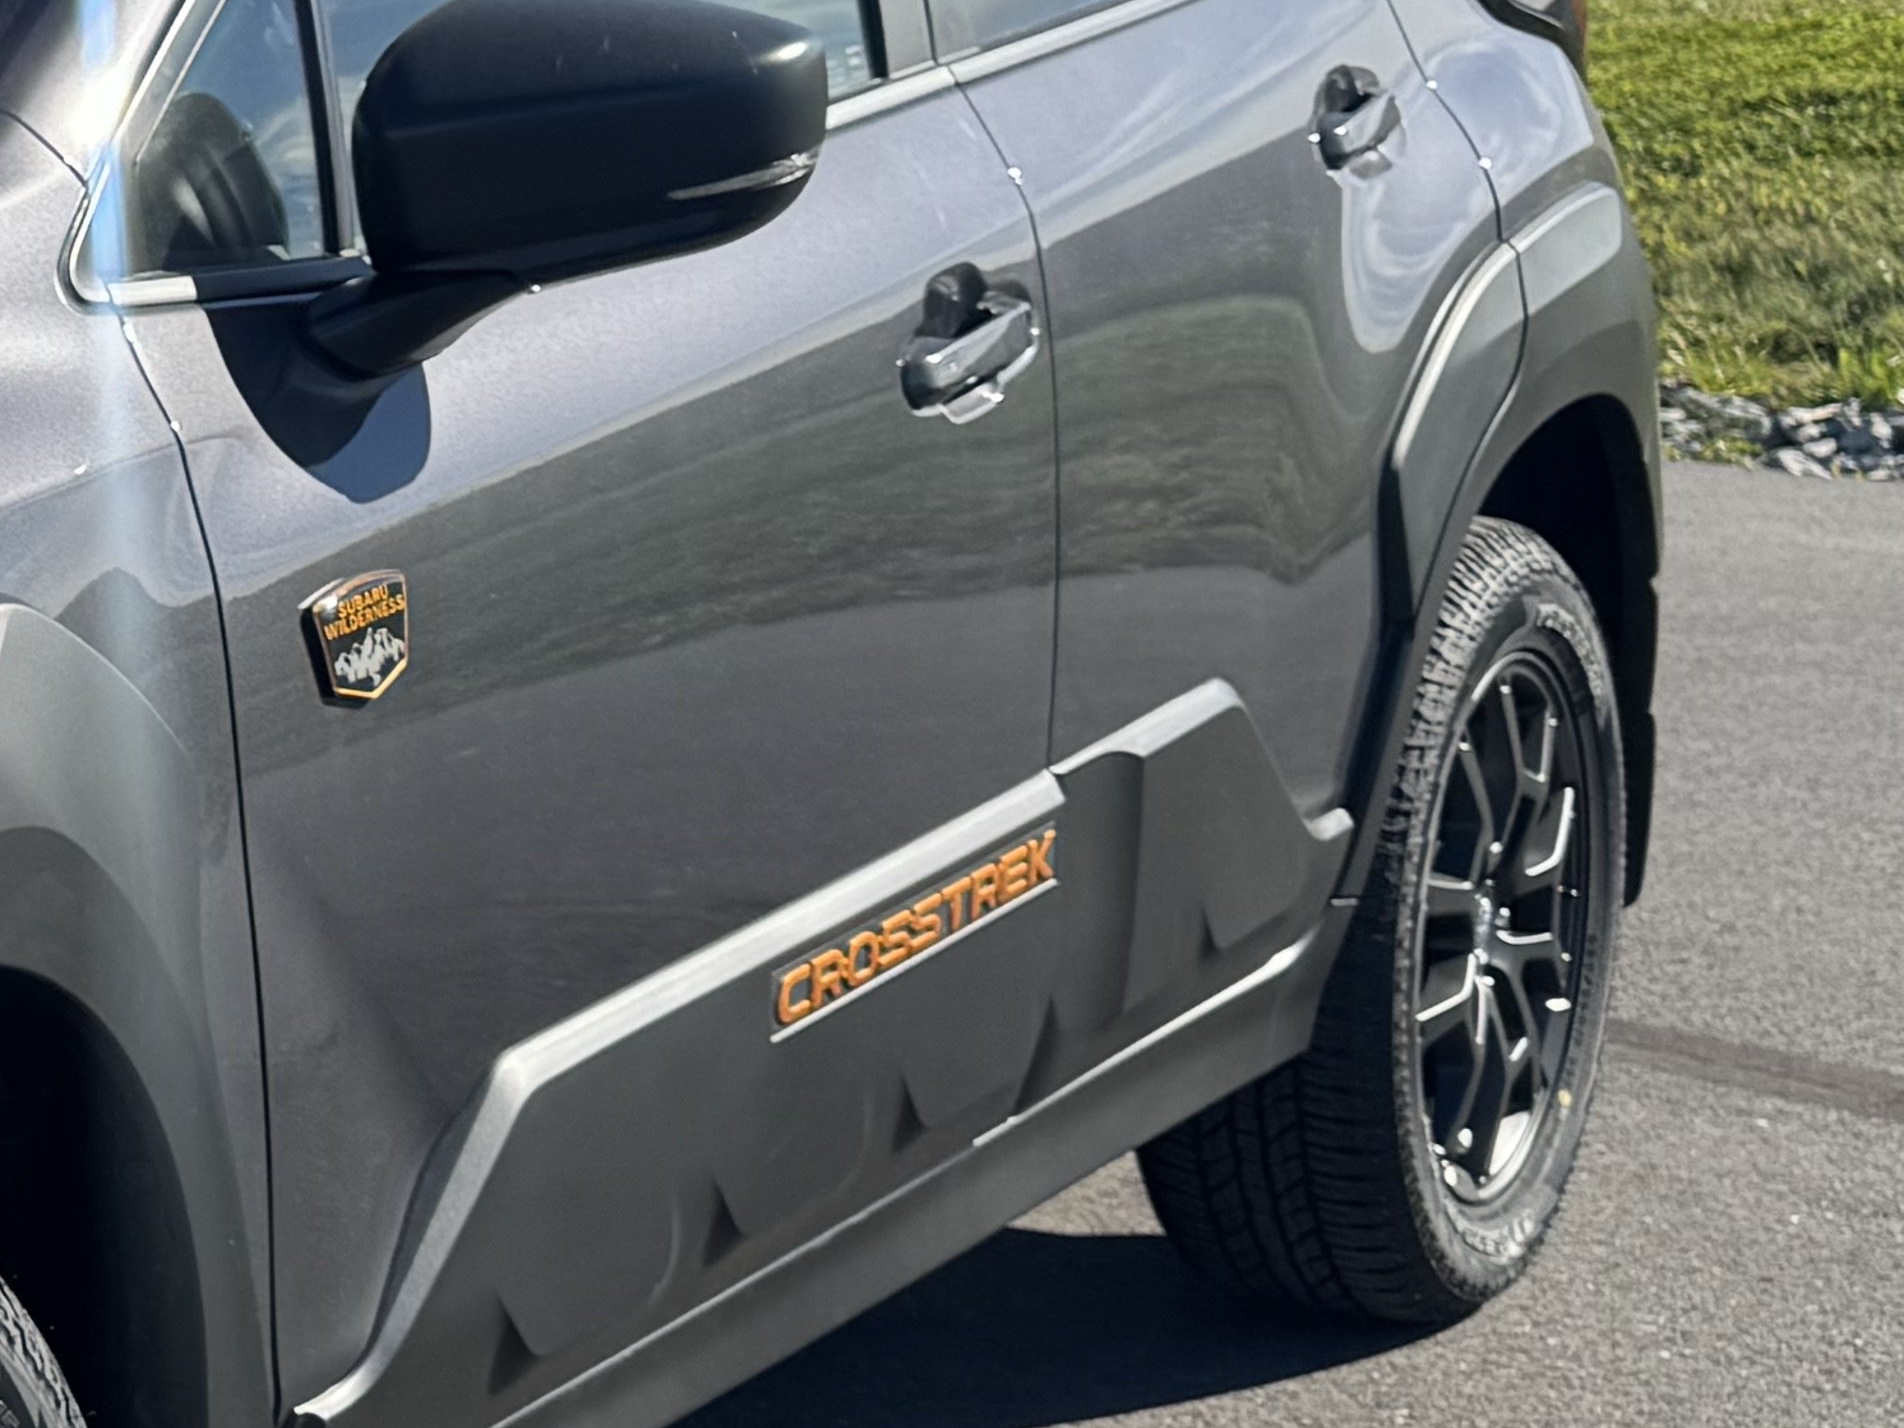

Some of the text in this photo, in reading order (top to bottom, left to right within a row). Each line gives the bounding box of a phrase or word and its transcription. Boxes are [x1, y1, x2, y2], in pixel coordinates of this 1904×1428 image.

[323, 593, 406, 641] WILDERNESS
[338, 584, 389, 619] SUBARU
[777, 829, 1057, 1025] CROSSTREK
